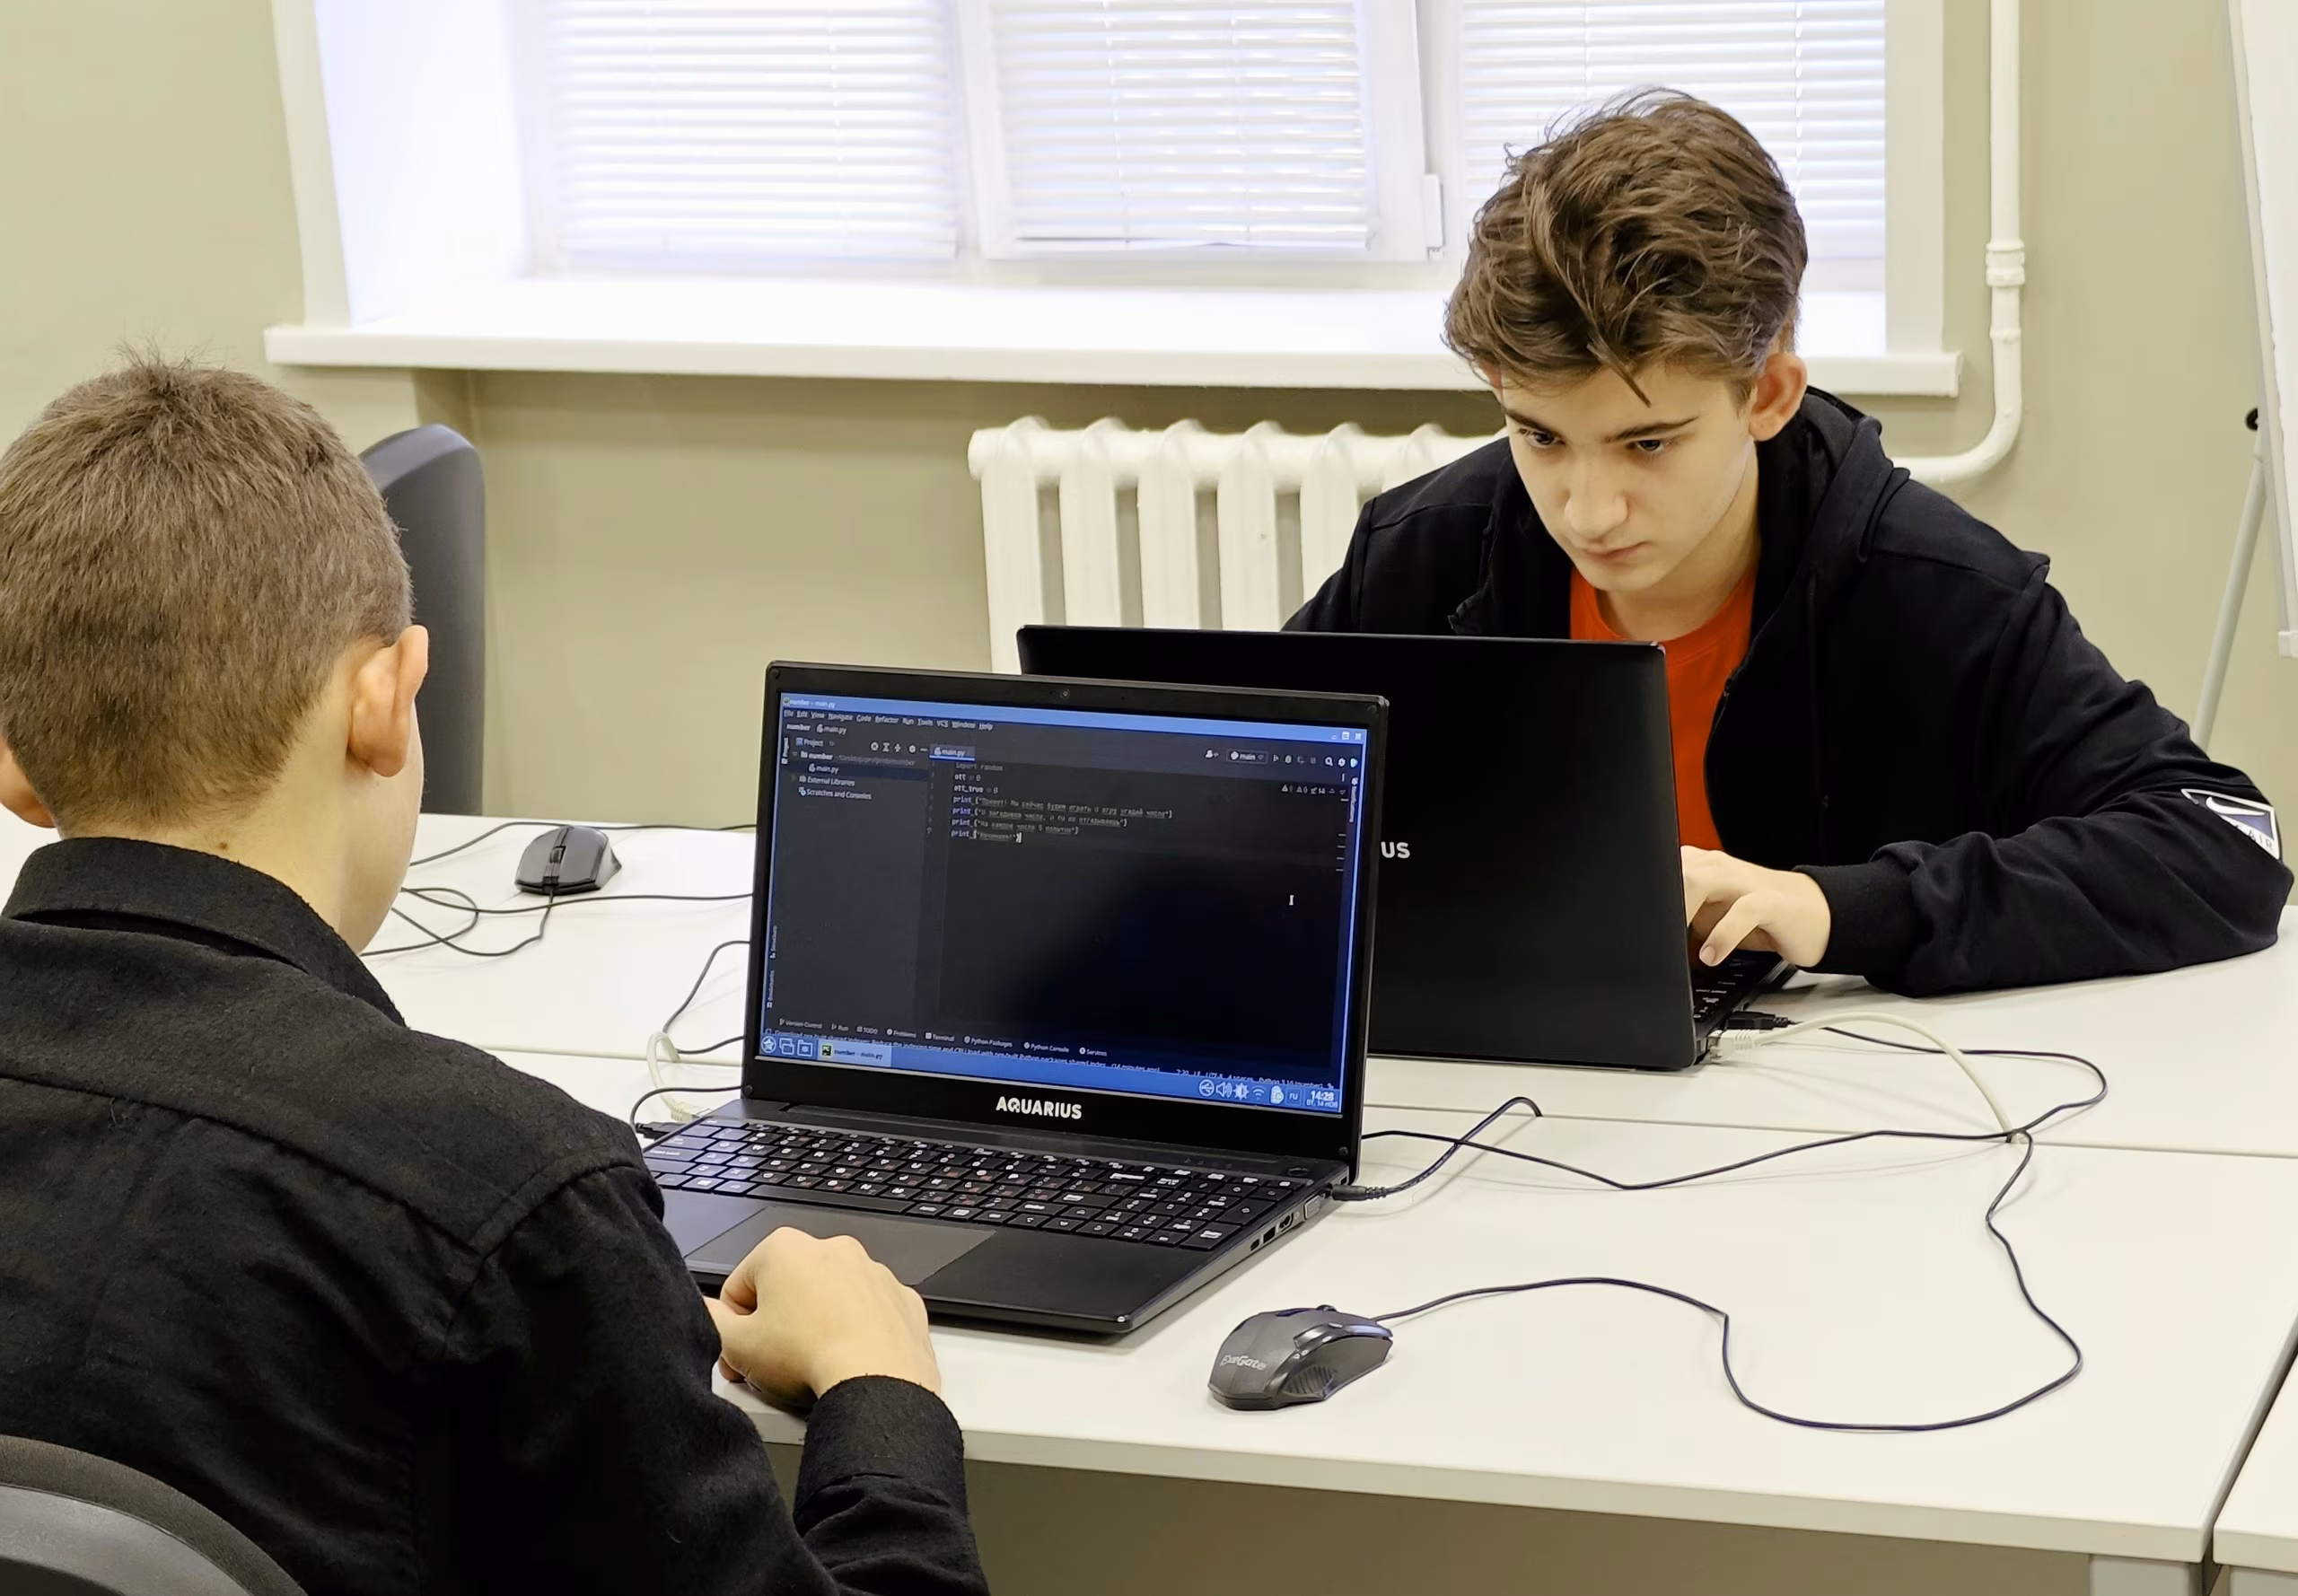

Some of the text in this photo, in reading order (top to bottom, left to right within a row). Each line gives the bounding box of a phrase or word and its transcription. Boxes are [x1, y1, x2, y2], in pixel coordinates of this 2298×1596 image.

[828, 713, 853, 722] Navigate
[856, 715, 872, 723] Code
[874, 715, 899, 723] Refactor
[902, 717, 914, 726] Run
[917, 718, 933, 726] Tools
[936, 720, 949, 728] VCS
[952, 721, 976, 729] Window
[978, 722, 994, 732] Help
[786, 723, 846, 735] number main.py
[803, 739, 824, 748] Project
[809, 752, 833, 760] number
[942, 749, 966, 758] main.py
[1240, 753, 1256, 761] main
[816, 765, 839, 775] main.py
[808, 776, 855, 786] External Libraries
[807, 788, 833, 798] Scratches
[846, 792, 873, 800] Consoles
[1381, 841, 1410, 859] US
[864, 1027, 878, 1035] TODO
[970, 1037, 1013, 1048] Python Packages
[1031, 1043, 1069, 1054] Python Console
[1086, 1048, 1108, 1057] Services
[861, 1051, 883, 1060] main.py
[1289, 1092, 1298, 1101] ru
[996, 1096, 1083, 1120] AQUARIUS
